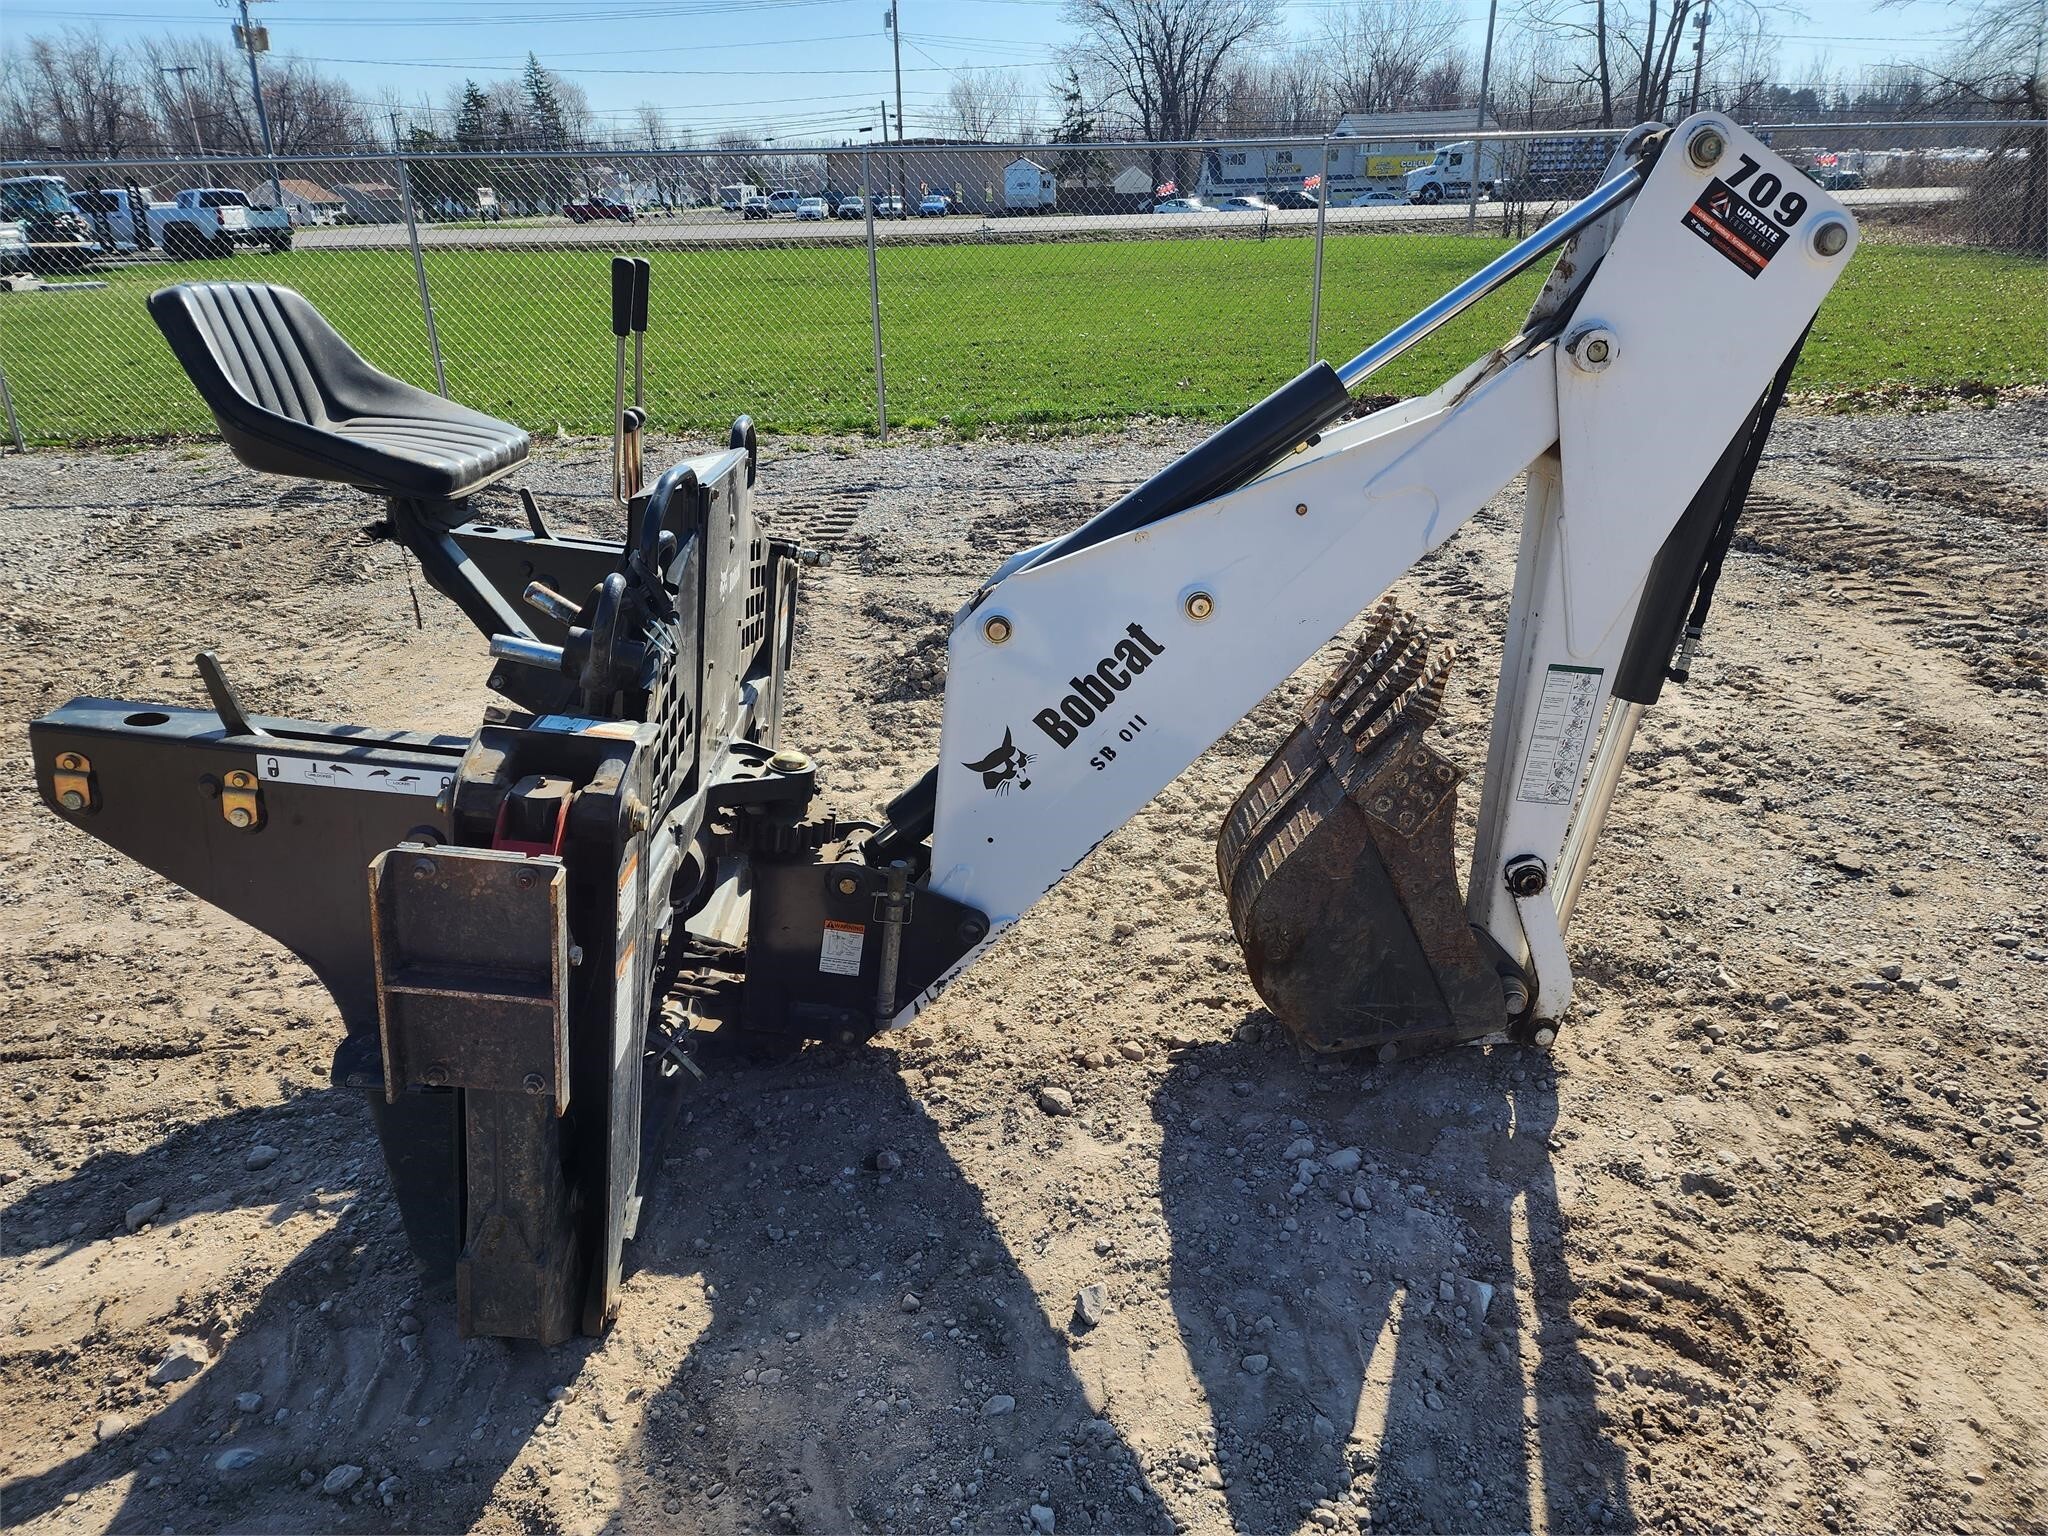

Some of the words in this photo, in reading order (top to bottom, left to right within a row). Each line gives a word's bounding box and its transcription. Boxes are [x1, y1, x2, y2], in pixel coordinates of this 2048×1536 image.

[1725, 153, 1807, 227] 709
[1728, 217, 1771, 252] EQUIPMENT
[1736, 206, 1779, 243] UPSTATE
[1032, 622, 1166, 750] Bobcat
[1090, 746, 1117, 771] SB
